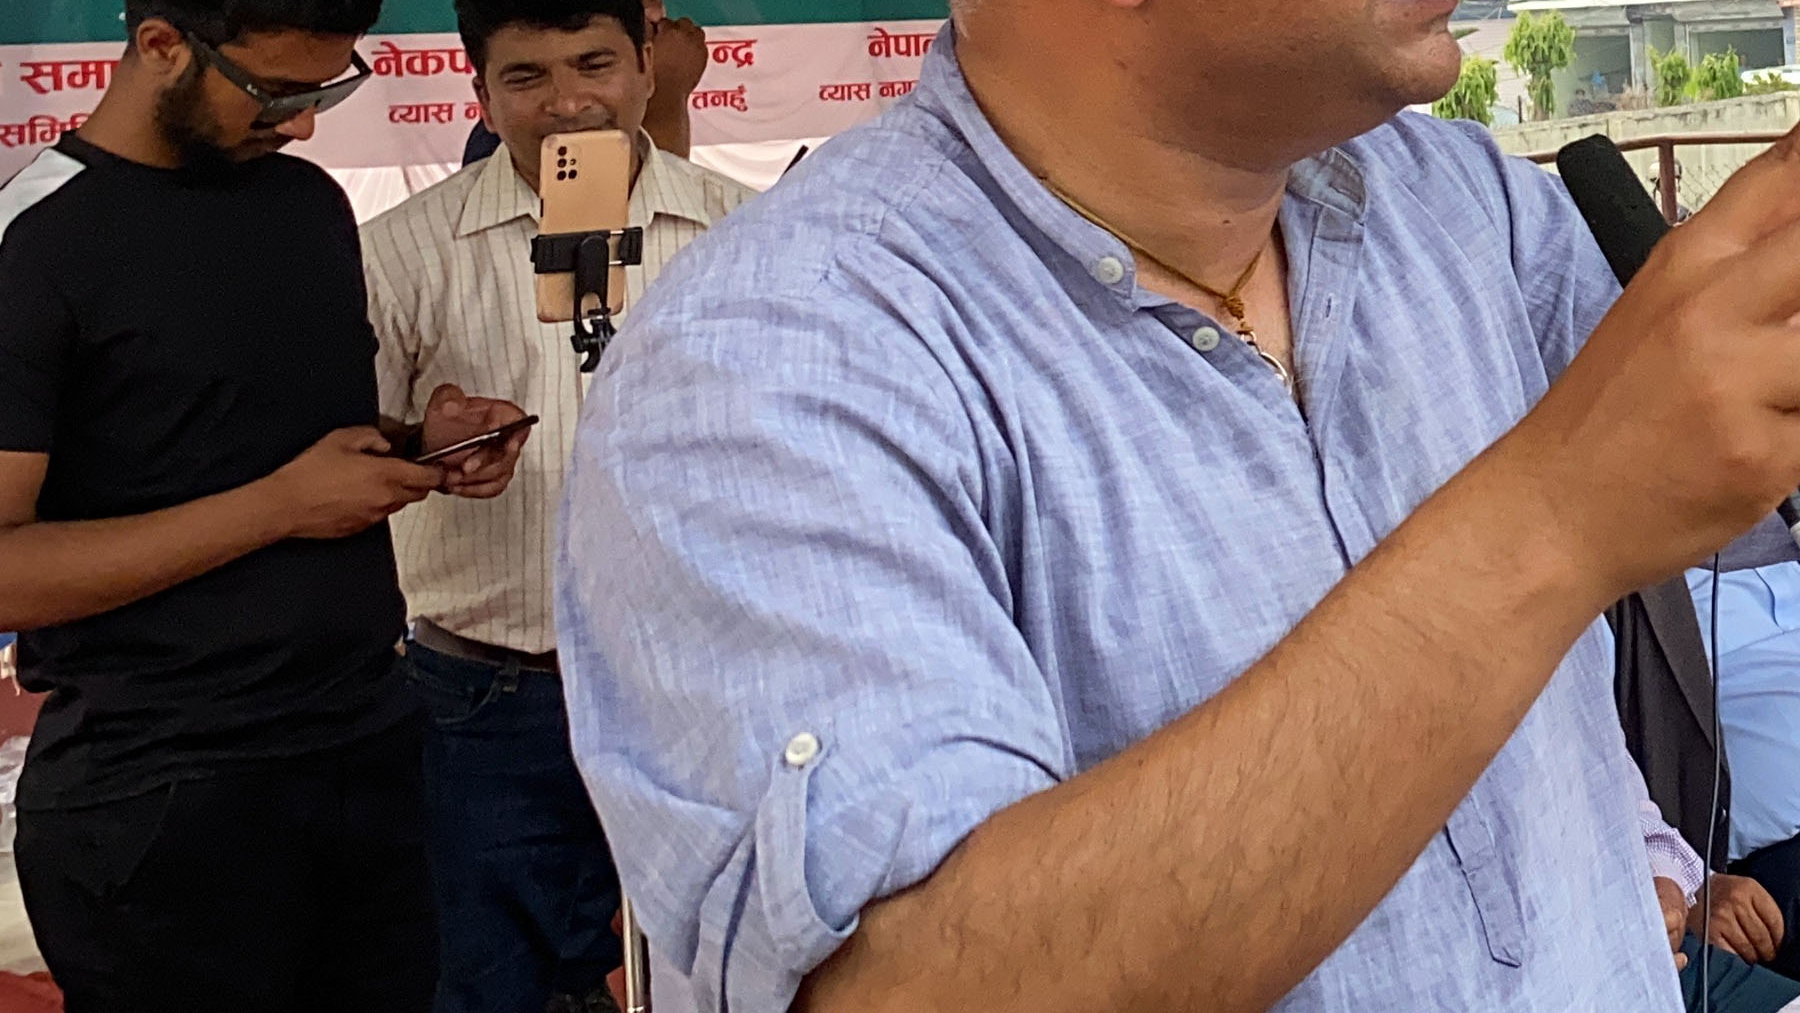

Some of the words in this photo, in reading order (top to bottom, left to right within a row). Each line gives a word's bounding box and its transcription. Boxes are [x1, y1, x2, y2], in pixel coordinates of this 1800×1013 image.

[705, 39, 758, 68] न्द्र
[20, 60, 120, 95] सम
[819, 82, 872, 101] व्यास
[388, 102, 456, 124] व्यास
